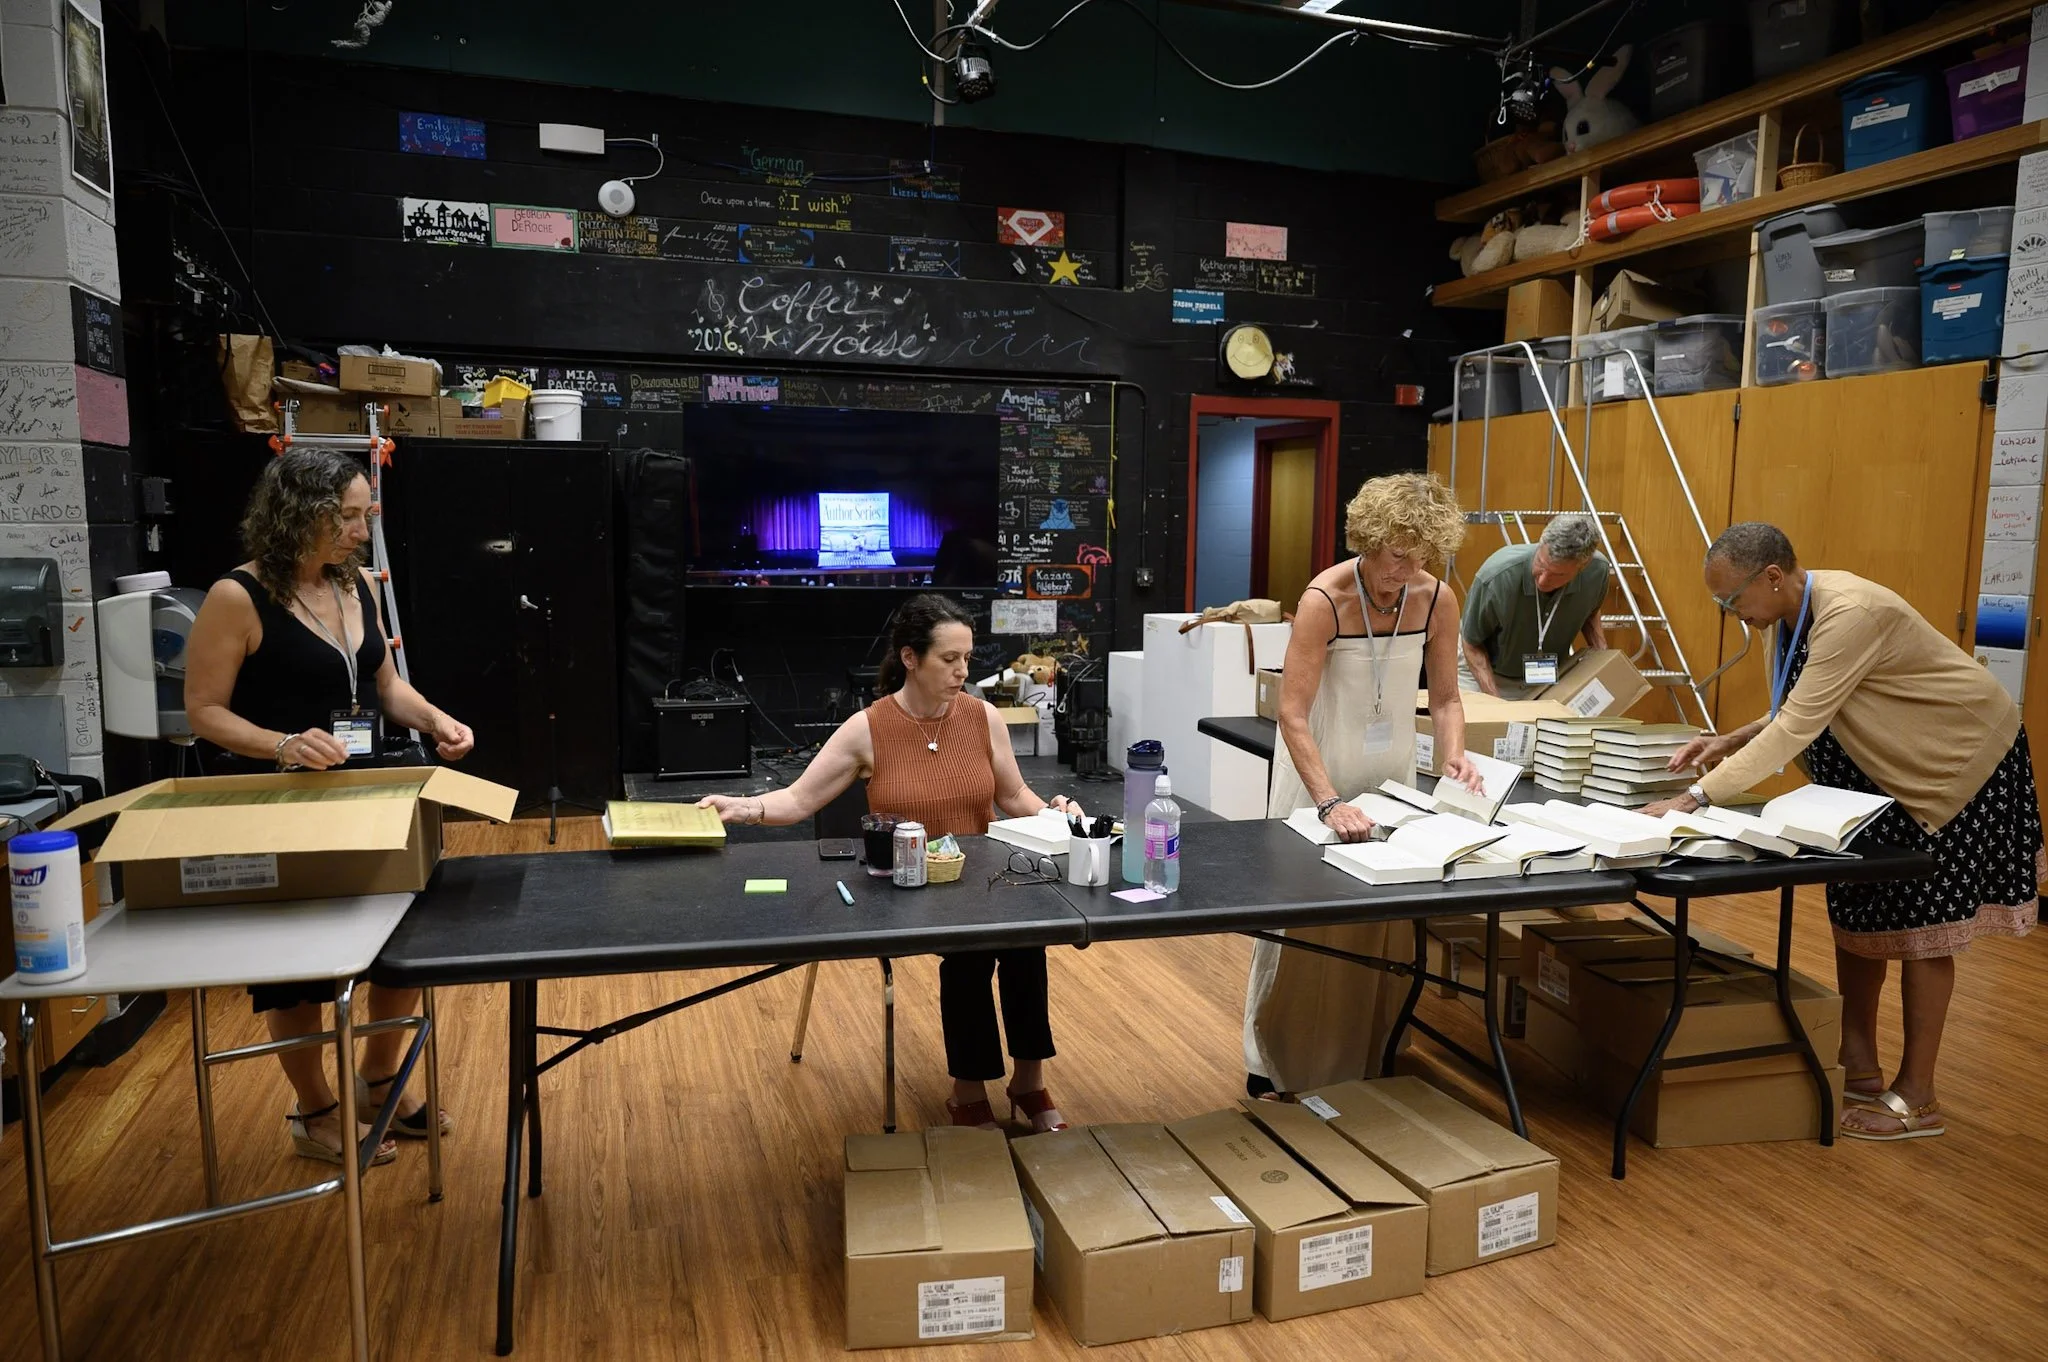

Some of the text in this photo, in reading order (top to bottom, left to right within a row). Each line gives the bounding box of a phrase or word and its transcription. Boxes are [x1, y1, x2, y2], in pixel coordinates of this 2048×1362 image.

[416, 118, 450, 133] Emily
[750, 148, 804, 173] German
[700, 191, 723, 205] Once
[726, 198, 745, 208] upon
[738, 276, 880, 325] Coffee
[694, 327, 738, 352] 2026
[794, 323, 928, 359] House
[547, 379, 618, 393] PAGLICCIA
[566, 369, 597, 381] MIA
[1000, 388, 1046, 412] Angela
